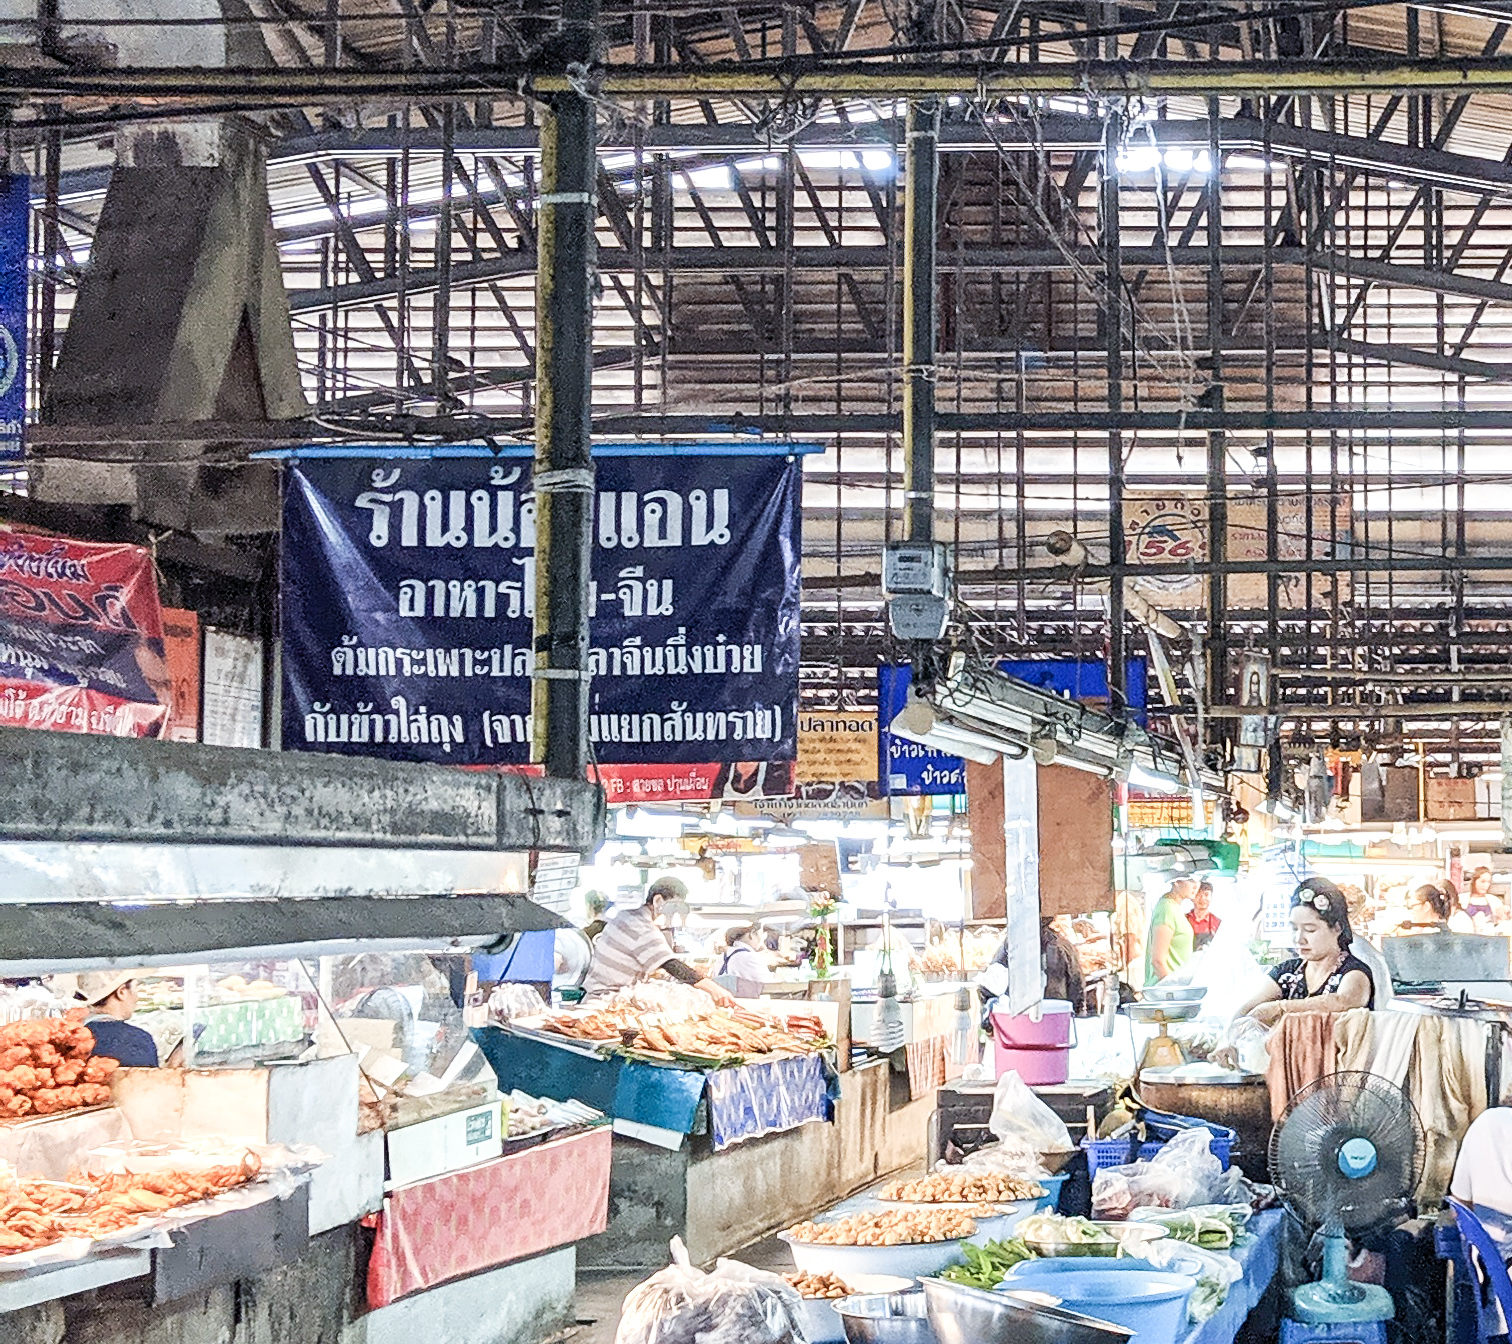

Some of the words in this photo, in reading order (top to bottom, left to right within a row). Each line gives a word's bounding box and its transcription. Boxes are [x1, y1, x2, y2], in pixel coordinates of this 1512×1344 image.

[399, 557, 673, 617] อาหารไ-จีน
[305, 695, 464, 752] กับข้าวใส่ถุง
